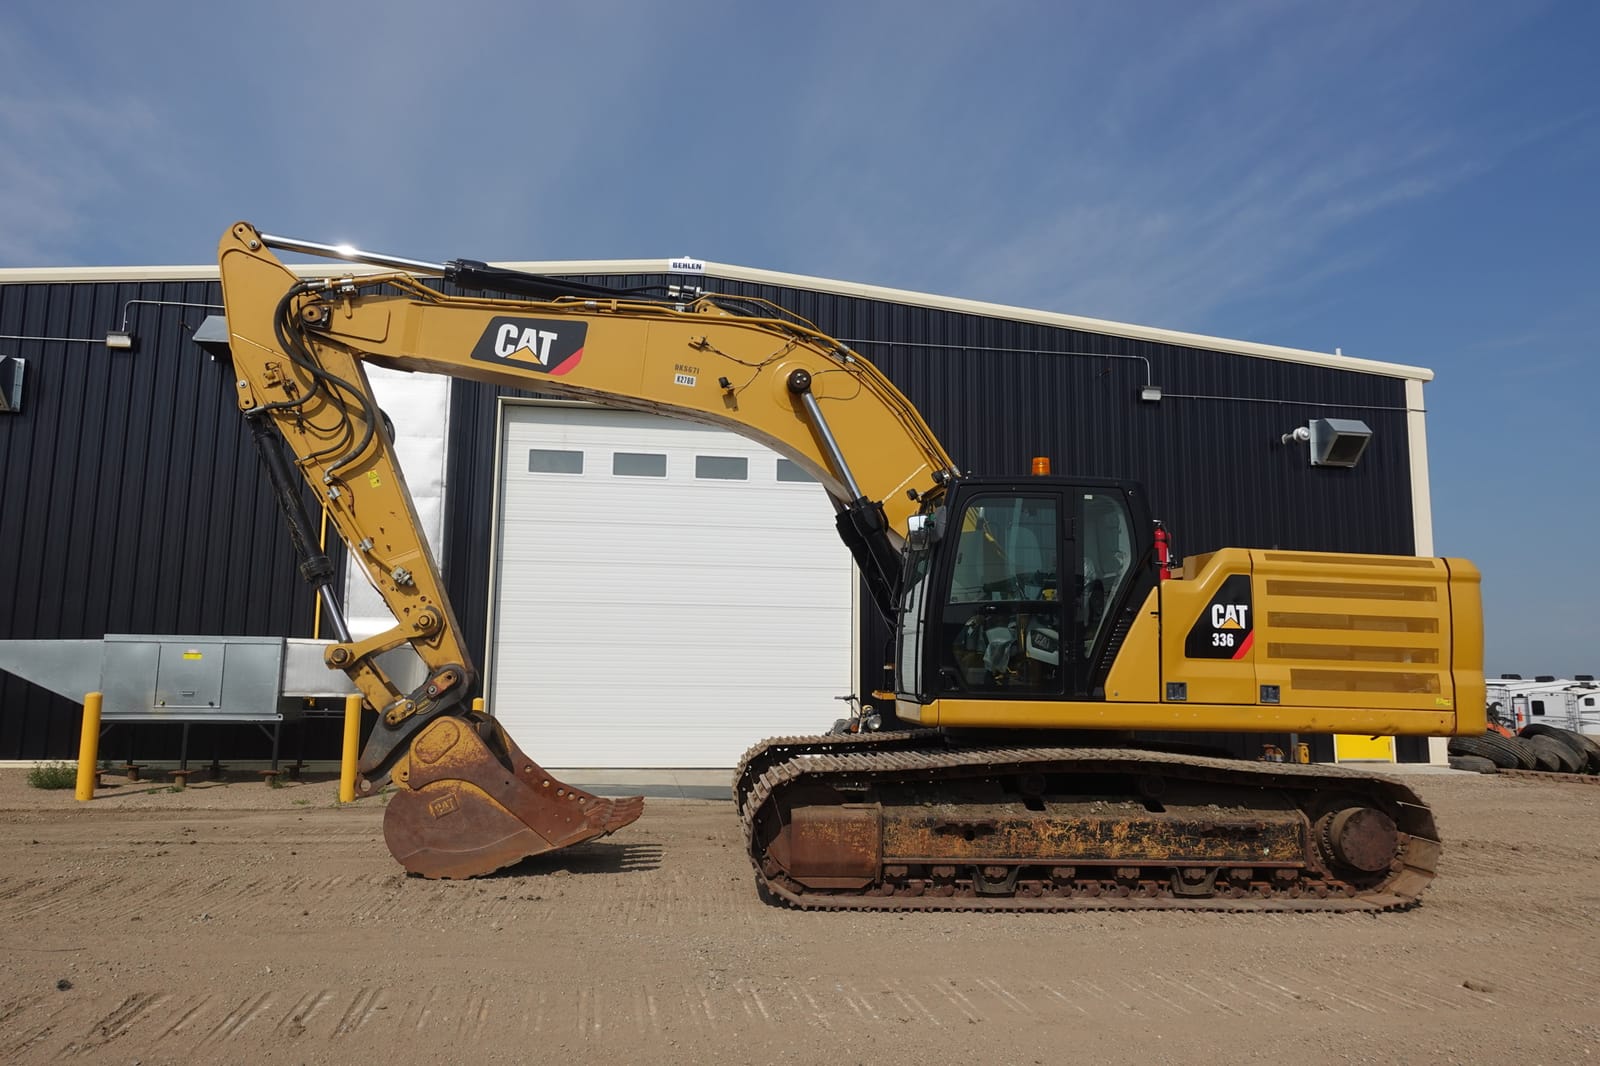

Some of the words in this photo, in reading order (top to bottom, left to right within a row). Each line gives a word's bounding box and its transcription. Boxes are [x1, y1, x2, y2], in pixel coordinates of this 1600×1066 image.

[672, 262, 702, 270] BEHLEN
[495, 323, 558, 366] CAT
[1211, 603, 1248, 629] CAT
[1212, 632, 1234, 647] 336
